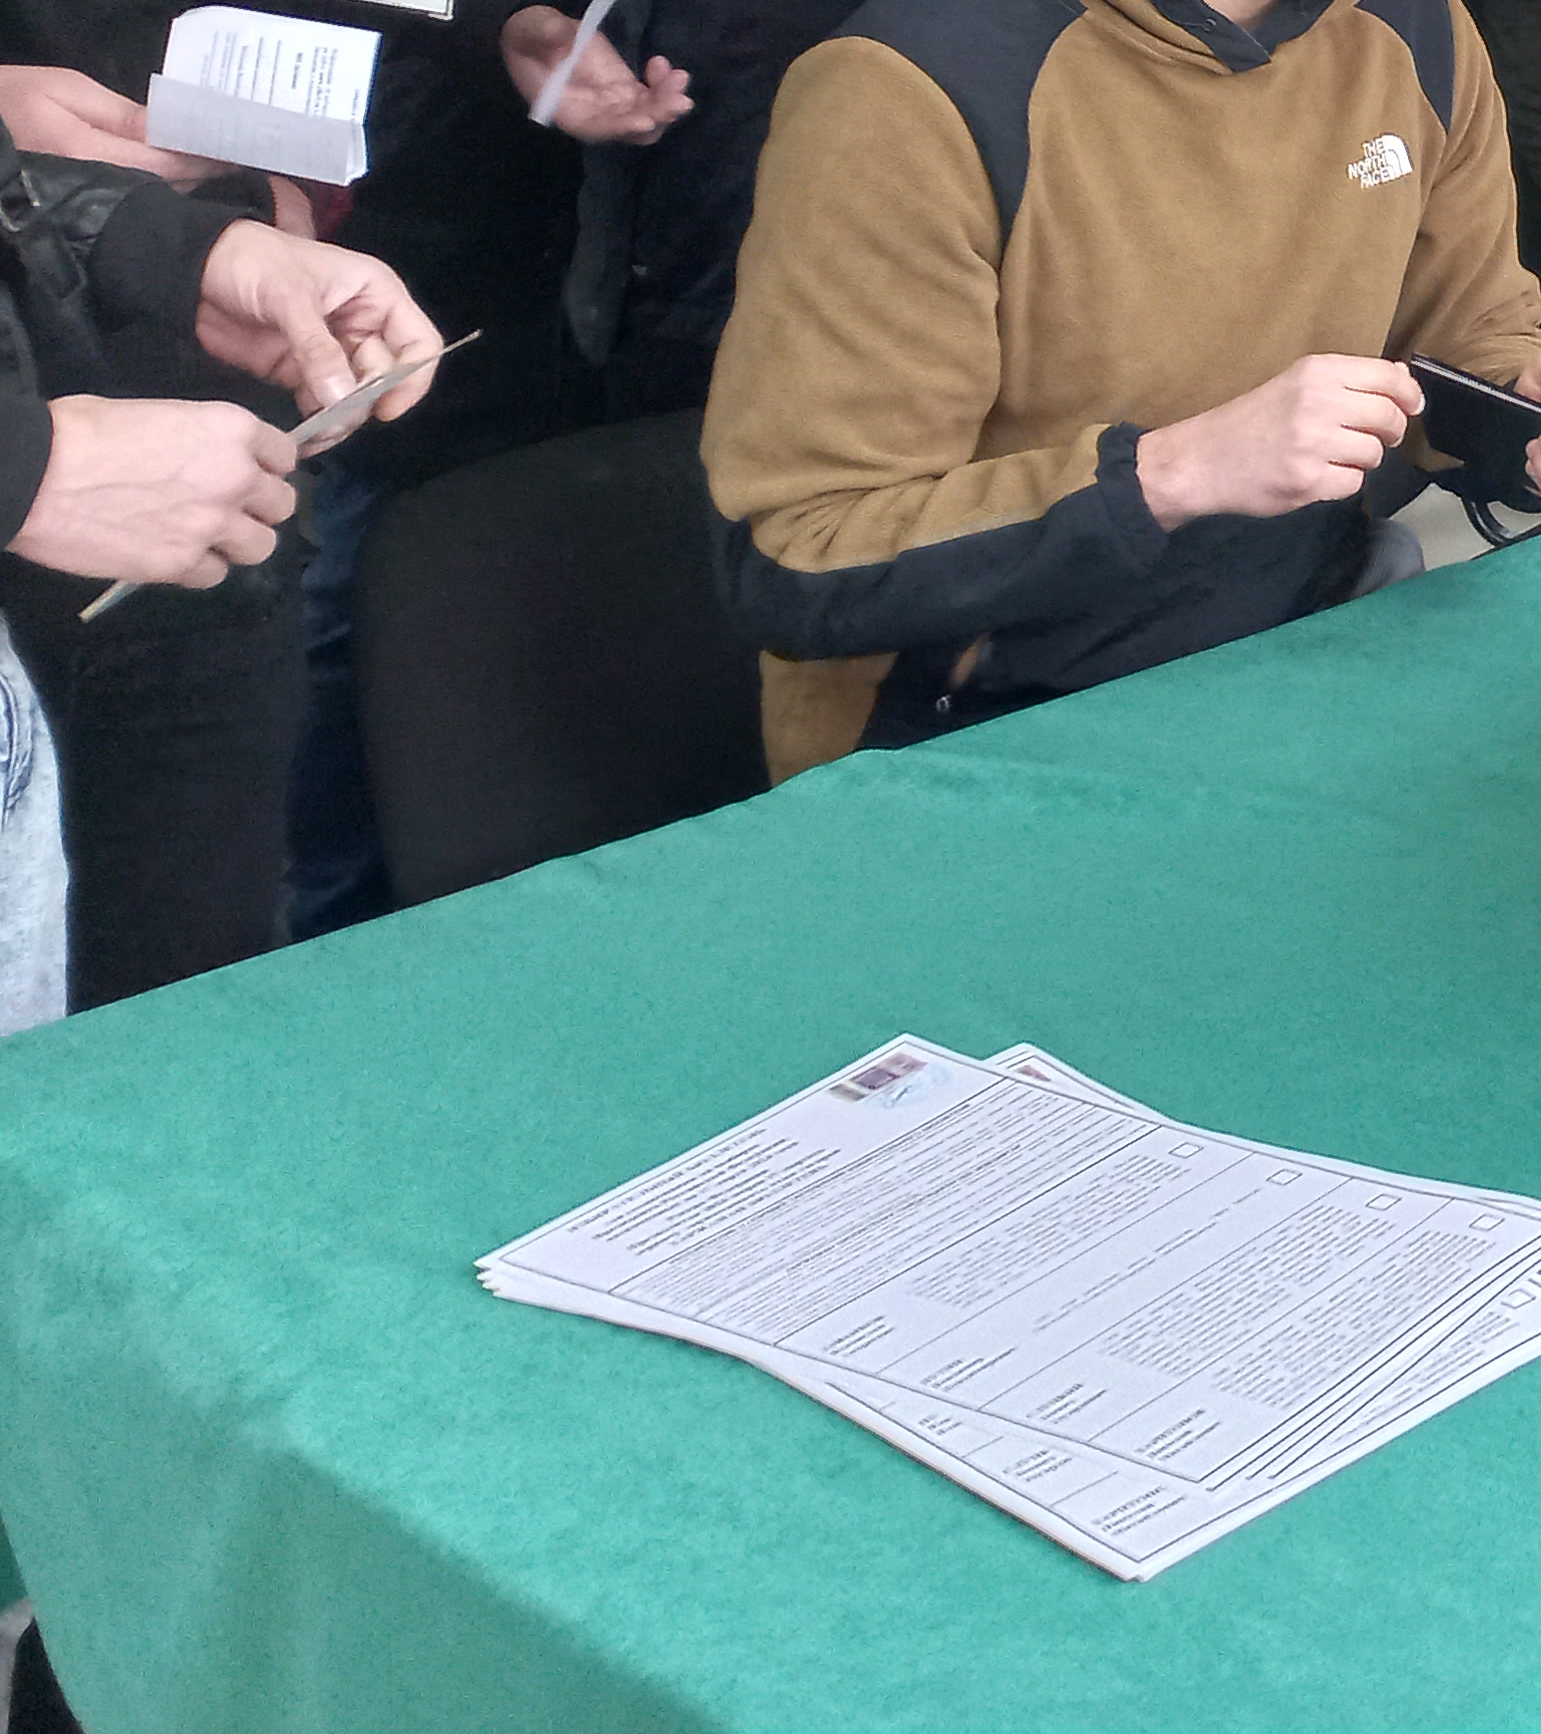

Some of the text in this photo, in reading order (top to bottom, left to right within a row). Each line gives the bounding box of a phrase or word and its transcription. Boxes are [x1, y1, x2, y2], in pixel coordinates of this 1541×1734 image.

[1362, 138, 1386, 157] THE
[1348, 153, 1388, 179] NORTH
[1361, 168, 1391, 189] FACE
